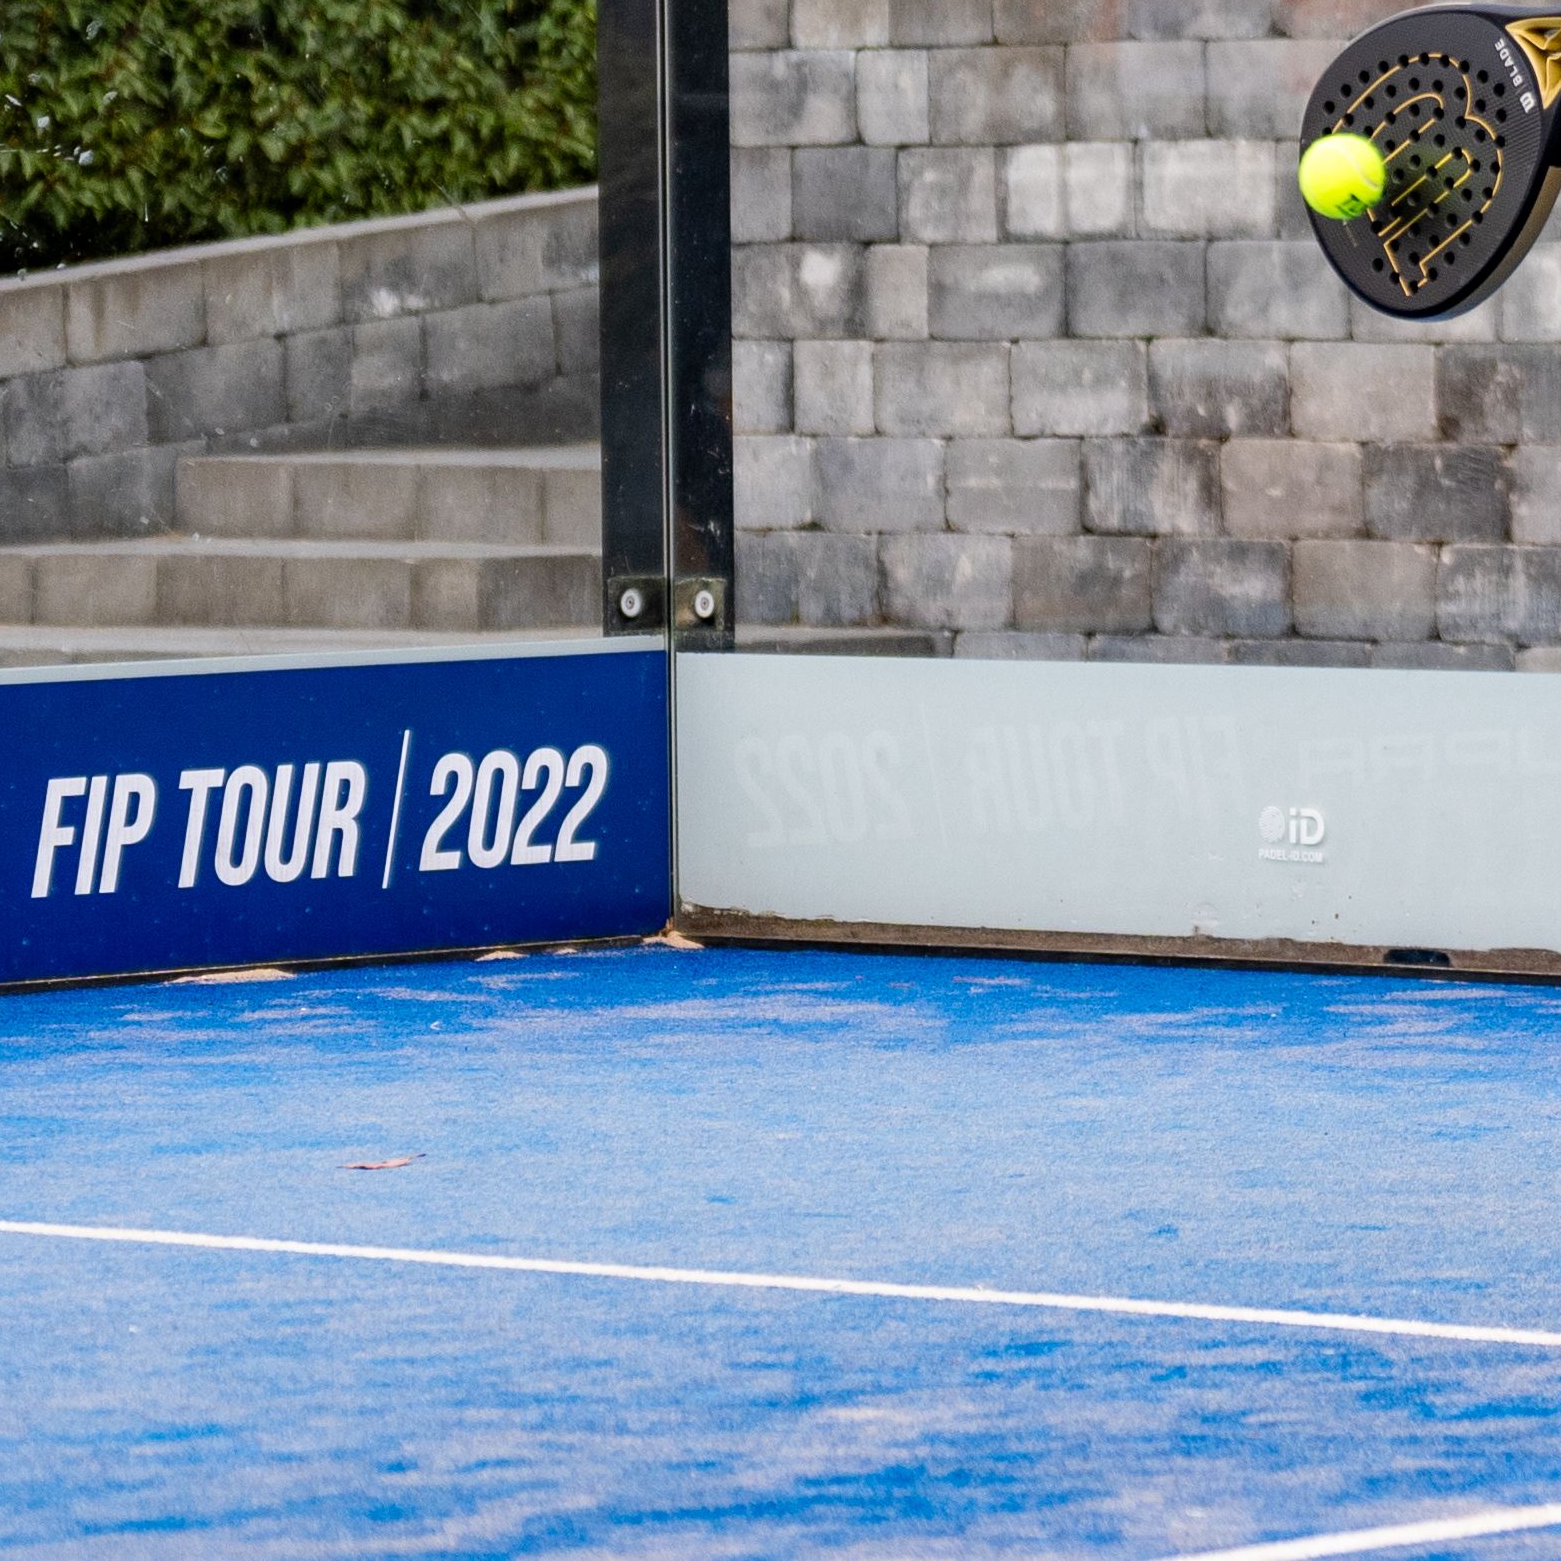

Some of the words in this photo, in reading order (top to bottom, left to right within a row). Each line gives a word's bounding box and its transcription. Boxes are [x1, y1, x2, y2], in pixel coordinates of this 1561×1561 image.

[1494, 38, 1523, 87] BLADE
[30, 773, 155, 898] FIP
[176, 760, 367, 890] TOUR
[418, 744, 608, 872] 2022
